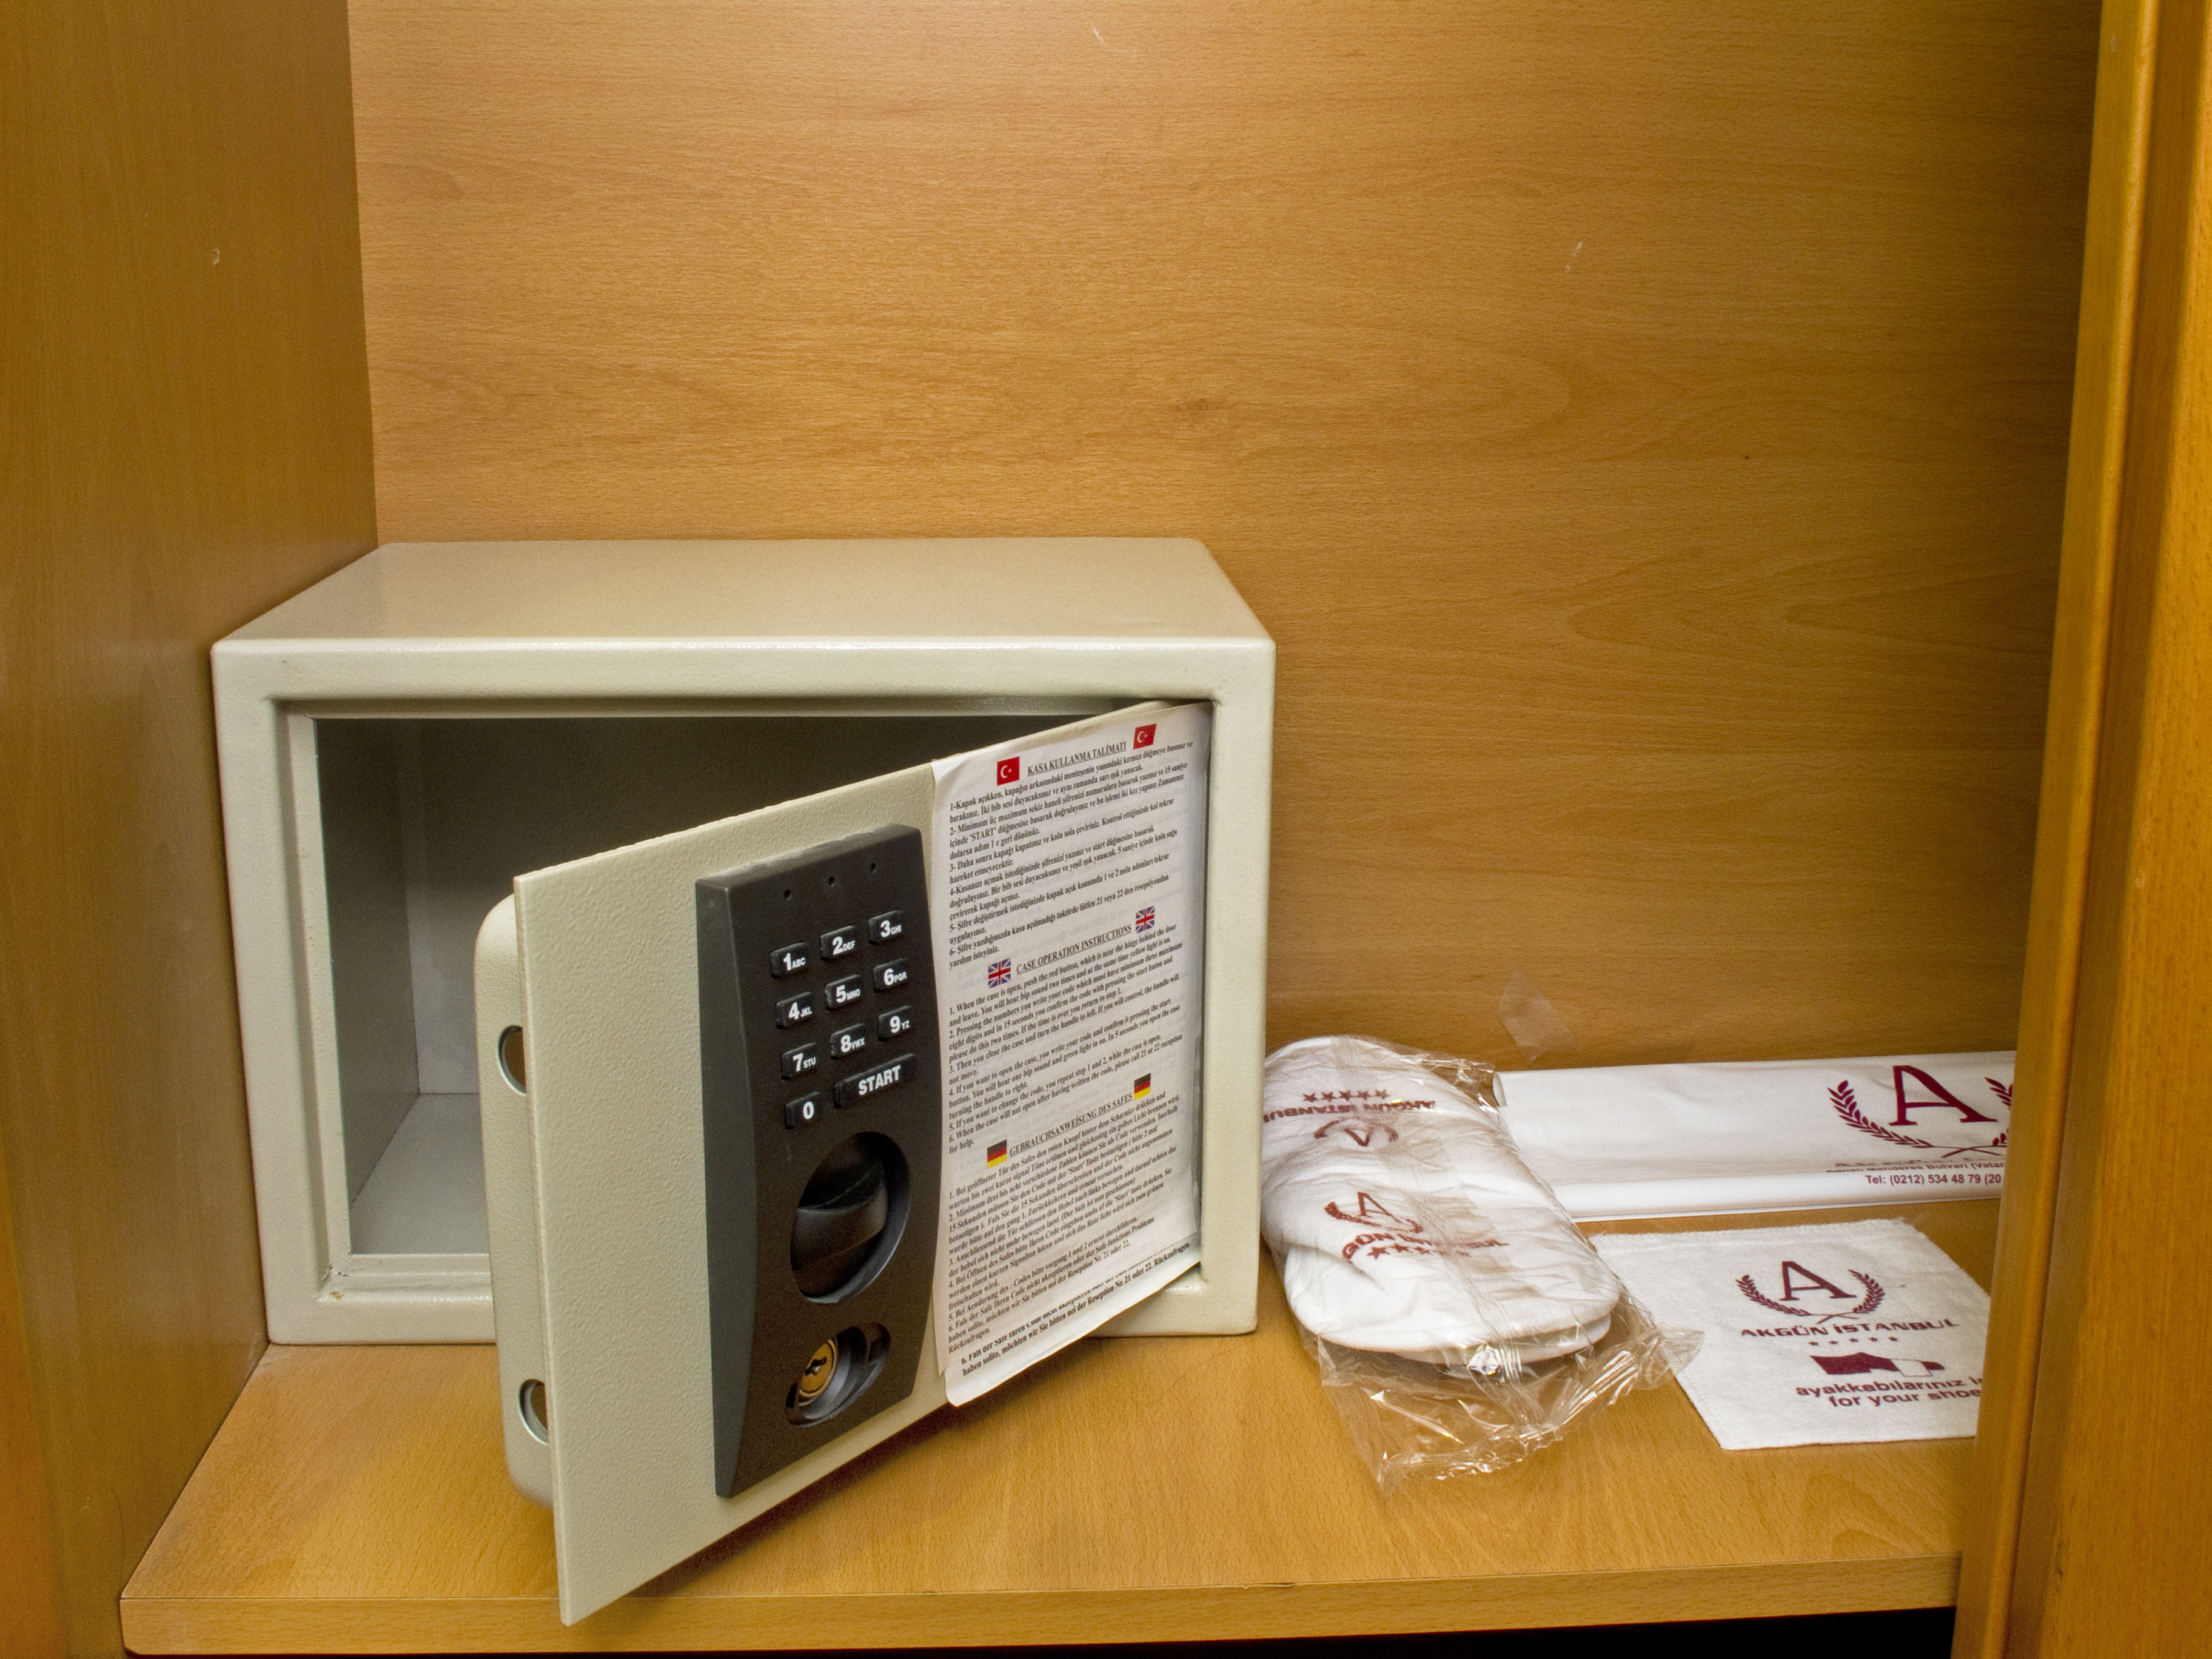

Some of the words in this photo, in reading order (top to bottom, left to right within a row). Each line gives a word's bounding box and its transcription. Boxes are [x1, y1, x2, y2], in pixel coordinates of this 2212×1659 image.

[1027, 762, 1048, 774] KASA
[1049, 751, 1090, 769] KULLANMA
[950, 810, 979, 823] bırakınız.
[981, 805, 990, 814] İki
[991, 802, 1001, 812] bib
[1002, 798, 1013, 808] sesi
[1014, 789, 1051, 805] duyacaksınız
[1060, 784, 1072, 794] aynı
[1073, 776, 1098, 789] zamanda
[1110, 769, 1119, 780] ışık
[1121, 763, 1142, 777] yanacak.
[977, 792, 1003, 803] açıkken,
[1004, 784, 1028, 796] kapağın
[1028, 773, 1062, 789] arkasındaki
[1064, 765, 1094, 780] menteşenin
[950, 848, 973, 860] dolarsa
[974, 843, 989, 853] adım
[1000, 834, 1012, 846] geri
[1013, 827, 1040, 841] dönünüz.
[984, 873, 1003, 885] açmak
[1004, 861, 1040, 879] istediğinizde
[1041, 853, 1064, 868] şifrenizi
[1065, 848, 1084, 862] yazınız
[1092, 841, 1105, 851] start
[1134, 825, 1154, 837] basarak
[950, 870, 973, 884] hareket
[974, 858, 1013, 876] etmeyecektir.
[949, 904, 977, 921] çevirerek
[979, 897, 999, 911] kapağı
[1000, 893, 1019, 903] açınız.
[950, 927, 986, 945] uygulayınız.
[1016, 959, 1036, 973] CASE
[1037, 943, 1079, 965] OPERATION
[1081, 925, 1131, 949] INSTRUCTIONS
[949, 955, 971, 970] yardım
[973, 945, 999, 960] isteyiniz.
[956, 1000, 974, 1011] When
[976, 996, 985, 1005] the
[986, 992, 999, 1001] case
[1006, 984, 1022, 995] open,
[1024, 976, 1037, 990] push
[1038, 973, 1048, 982] the
[1048, 968, 1058, 978] red
[1059, 962, 1079, 974] button,
[1079, 954, 1096, 965] which
[1102, 948, 1114, 957] near
[948, 1050, 968, 1064] please
[978, 1040, 989, 1050] this
[990, 1036, 1001, 1045] two
[1002, 1030, 1020, 1041] times.
[1027, 1022, 1036, 1031] the
[1037, 1017, 1050, 1027] time
[1056, 1009, 1069, 1019] over
[1070, 1005, 1080, 1016] you
[1081, 997, 1098, 1010] return
[1105, 990, 1116, 999] step
[858, 1065, 901, 1096] START
[948, 1075, 959, 1085] not
[960, 1069, 978, 1081] move.
[948, 1105, 972, 1119] turning
[973, 1101, 982, 1109] the
[984, 1091, 1004, 1105] handle
[1012, 1081, 1027, 1093] right.
[1098, 1104, 1111, 1114] DES
[1112, 1092, 1132, 1108] SAFES
[1888, 1065, 1999, 1126] A
[802, 1101, 814, 1120] 0
[948, 1145, 958, 1154] for
[959, 1138, 974, 1150] help.
[1865, 1175, 1886, 1184] Tel:
[1889, 1174, 1925, 1187] (0212)
[1928, 1174, 1948, 1184] 534
[1951, 1174, 1964, 1184] 48
[1967, 1174, 1981, 1184] 79
[1866, 1164, 1923, 1172] Menderes
[948, 1289, 982, 1310] freischalten
[984, 1278, 999, 1291] wird.
[1780, 1261, 1857, 1301] A
[962, 1361, 981, 1376] haben
[1001, 1335, 1027, 1354] möchten
[1028, 1328, 1038, 1338] wir
[1039, 1322, 1048, 1333] Sie
[1049, 1313, 1066, 1327] bitten
[1077, 1301, 1086, 1311] der
[1087, 1285, 1114, 1305] Reseption
[1114, 1280, 1124, 1289] Nr.
[1124, 1274, 1130, 1284] 21
[1131, 1268, 1144, 1279] oder
[1153, 1242, 1191, 1267] Rückzufragen.
[948, 1327, 990, 1354] Rückzufragen.
[1741, 1325, 1828, 1337] AKGÜN
[1834, 1319, 1959, 1334] İSTANBUL
[1829, 1395, 1861, 1407] for
[1869, 1392, 1920, 1406] your
